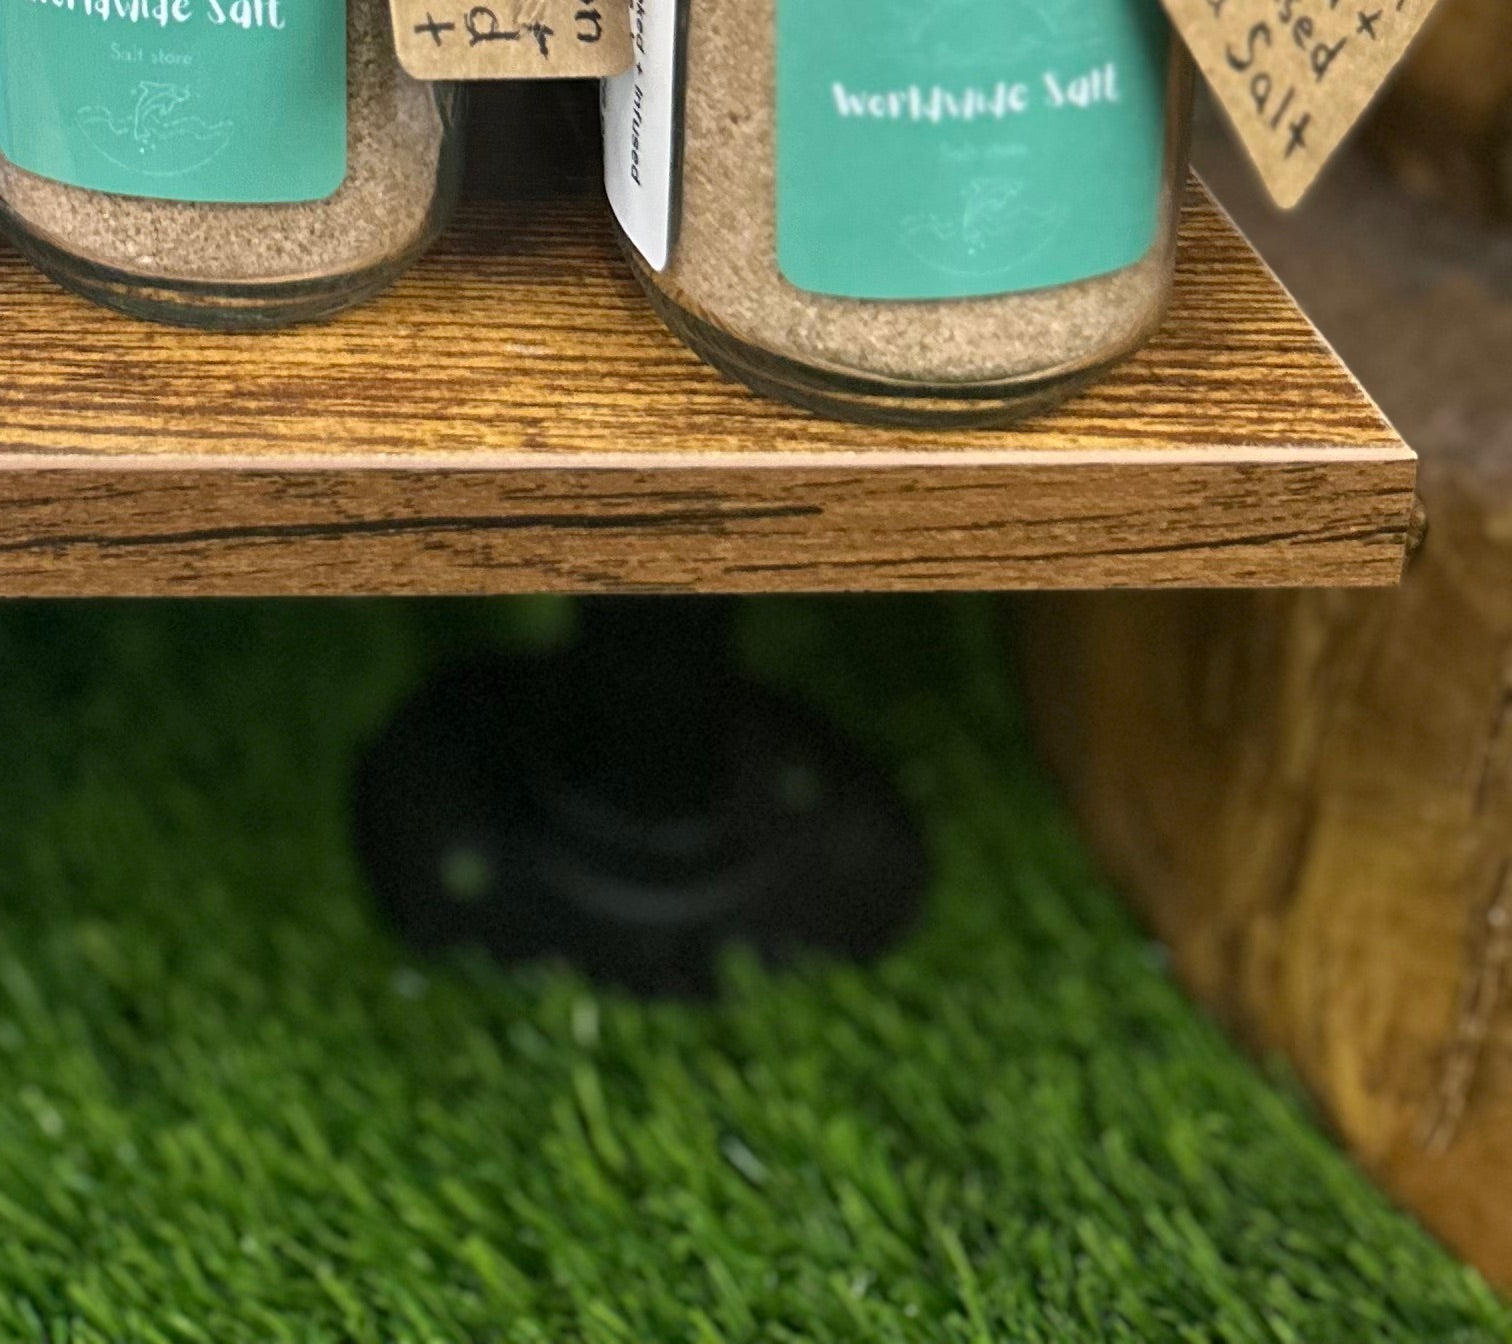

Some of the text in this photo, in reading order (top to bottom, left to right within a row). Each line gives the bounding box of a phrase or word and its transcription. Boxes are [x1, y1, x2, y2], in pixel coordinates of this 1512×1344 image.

[1356, 8, 1384, 40] +
[110, 43, 144, 62] Salt
[1043, 61, 1119, 108] Salt
[630, 83, 644, 187] Infused
